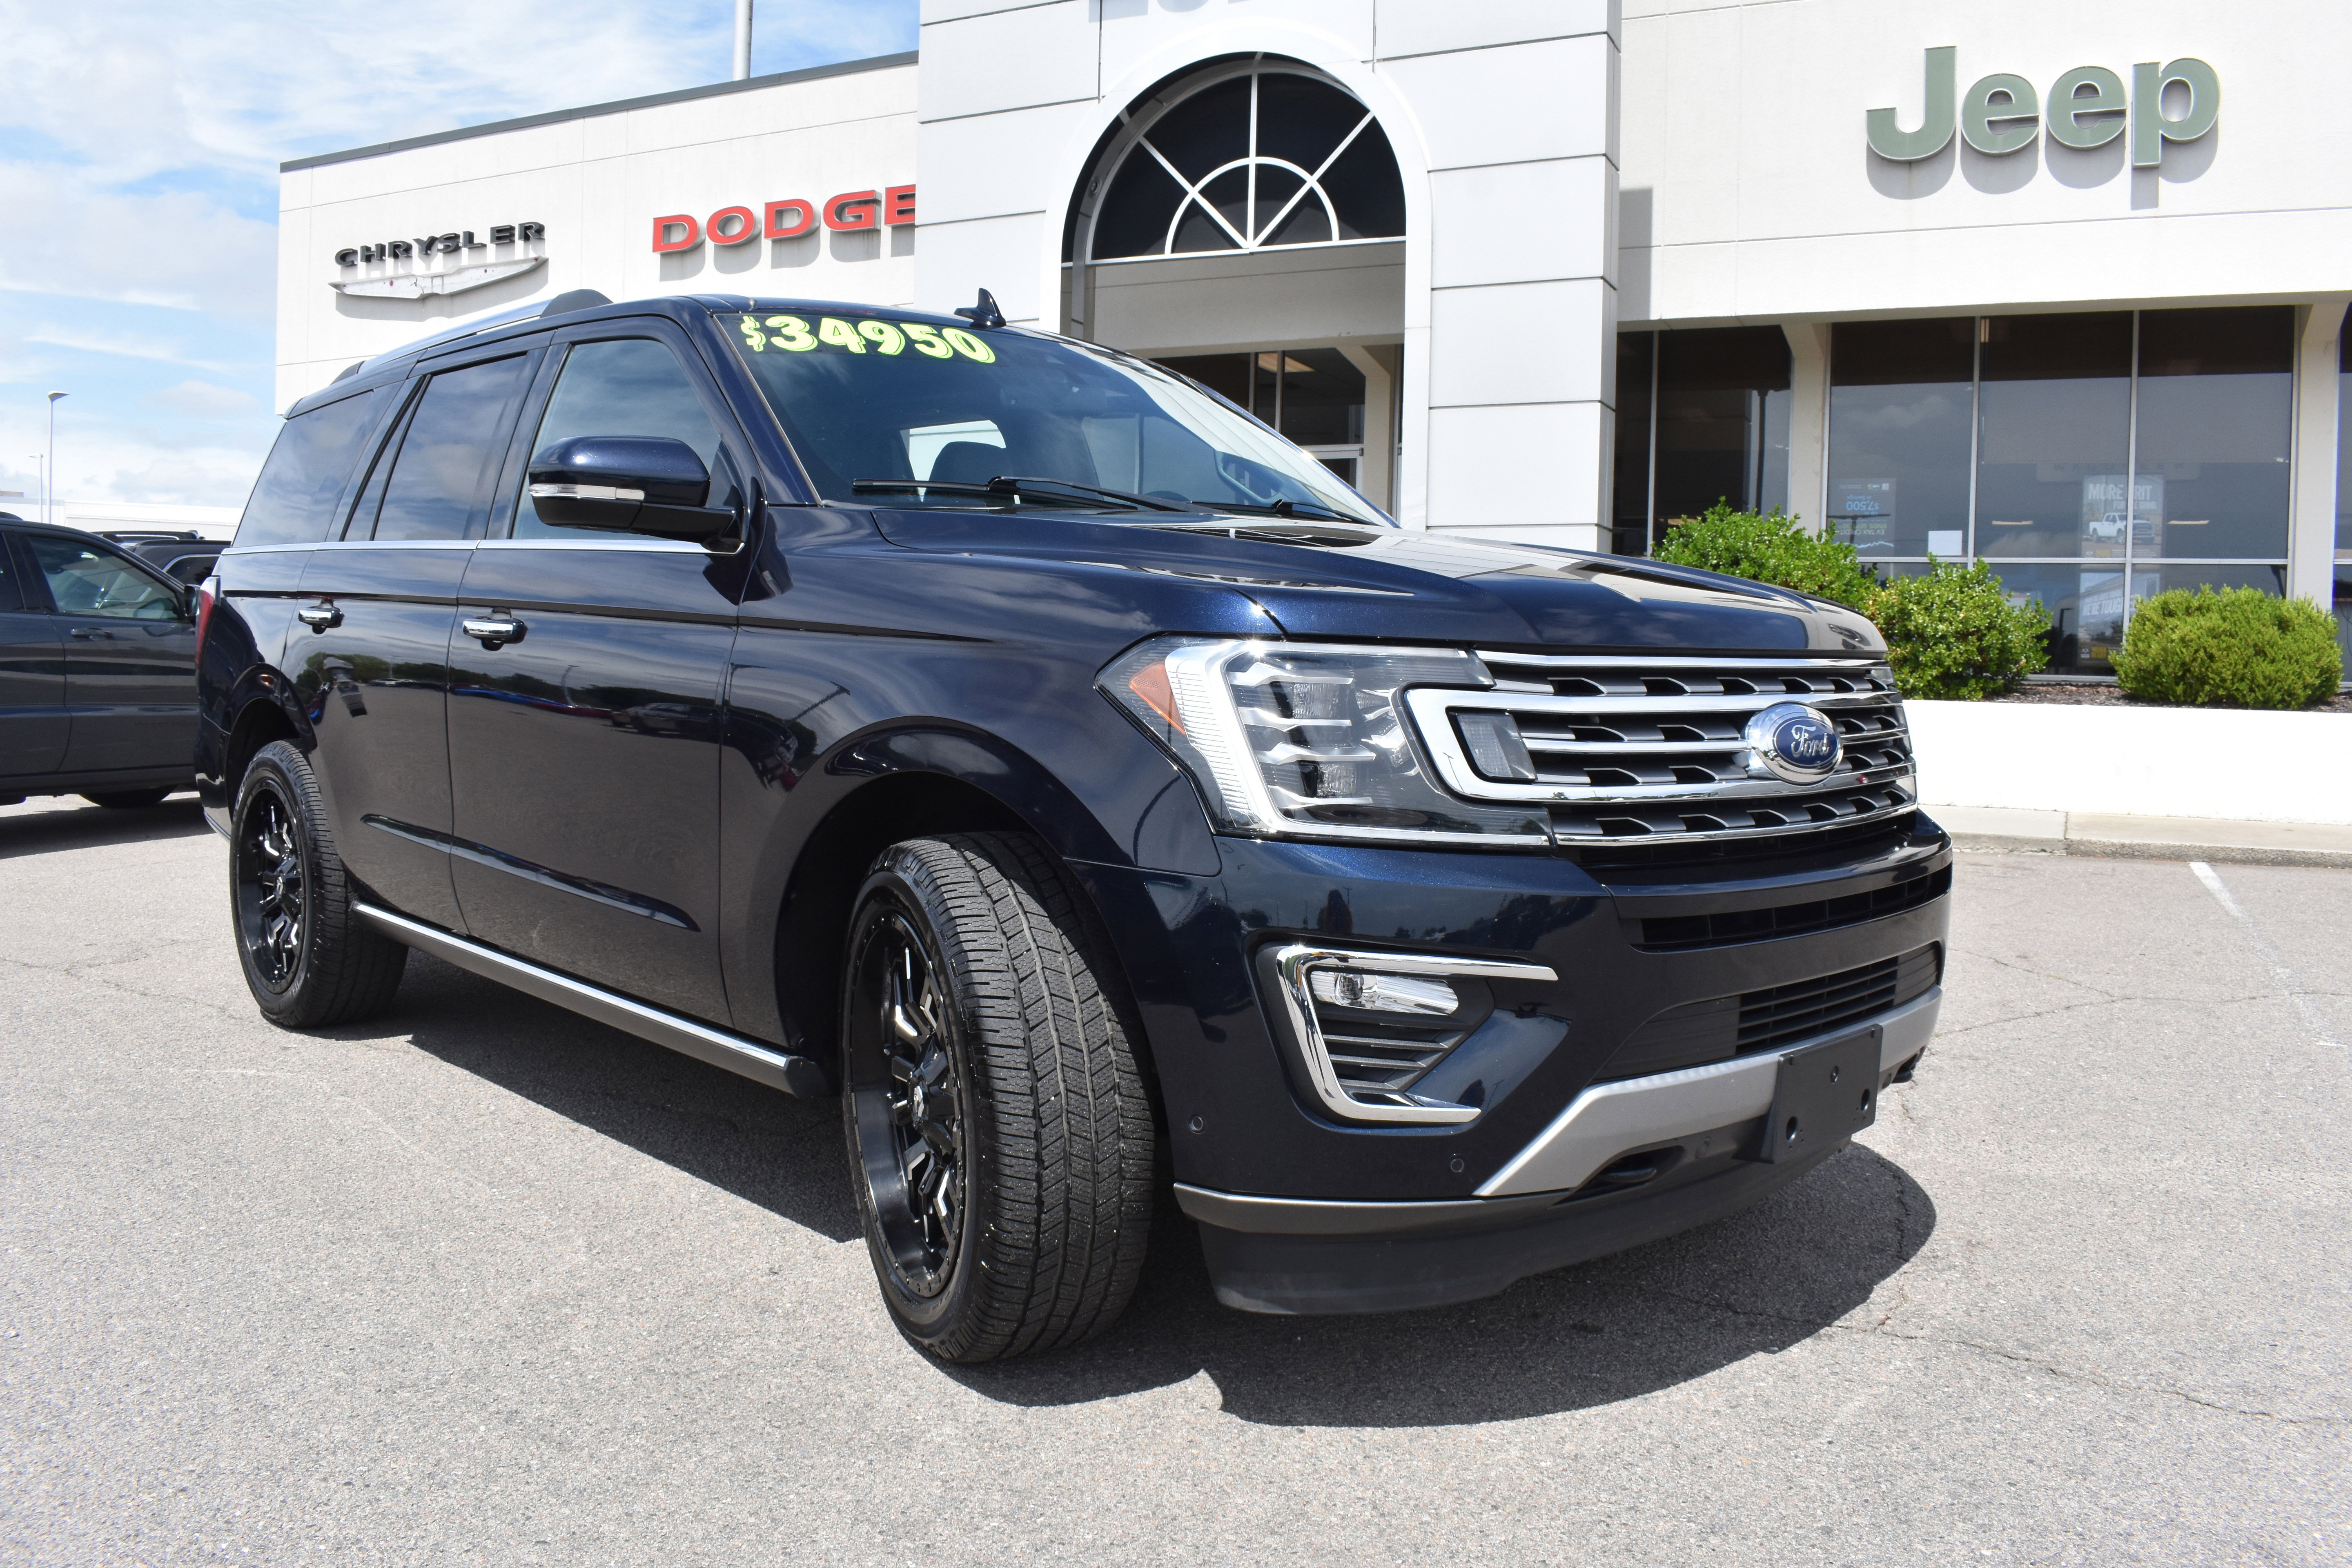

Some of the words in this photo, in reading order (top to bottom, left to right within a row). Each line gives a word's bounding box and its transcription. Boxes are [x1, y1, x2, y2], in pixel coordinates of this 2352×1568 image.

[1866, 46, 2221, 168] Jeep
[652, 184, 916, 255] DODGE
[334, 221, 546, 267] CHRYSLER
[740, 316, 996, 363] $34950
[2132, 485, 2153, 500] RIT
[1791, 724, 1830, 757] Ford
